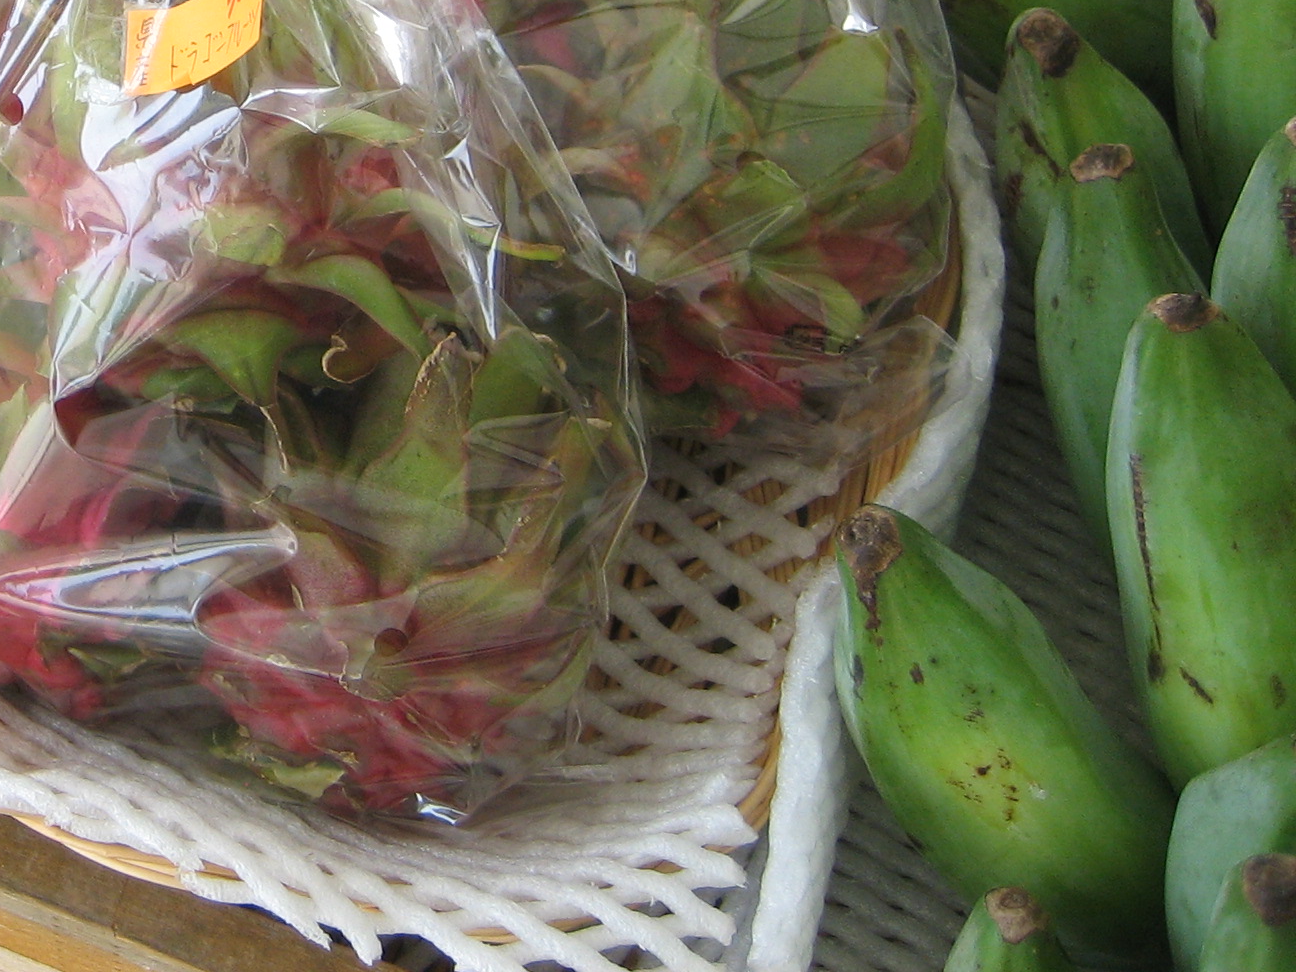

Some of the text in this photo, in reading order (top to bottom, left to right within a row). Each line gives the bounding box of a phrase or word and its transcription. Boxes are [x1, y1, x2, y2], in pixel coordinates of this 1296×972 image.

[170, 0, 261, 83] ドラゴンフルーツ
